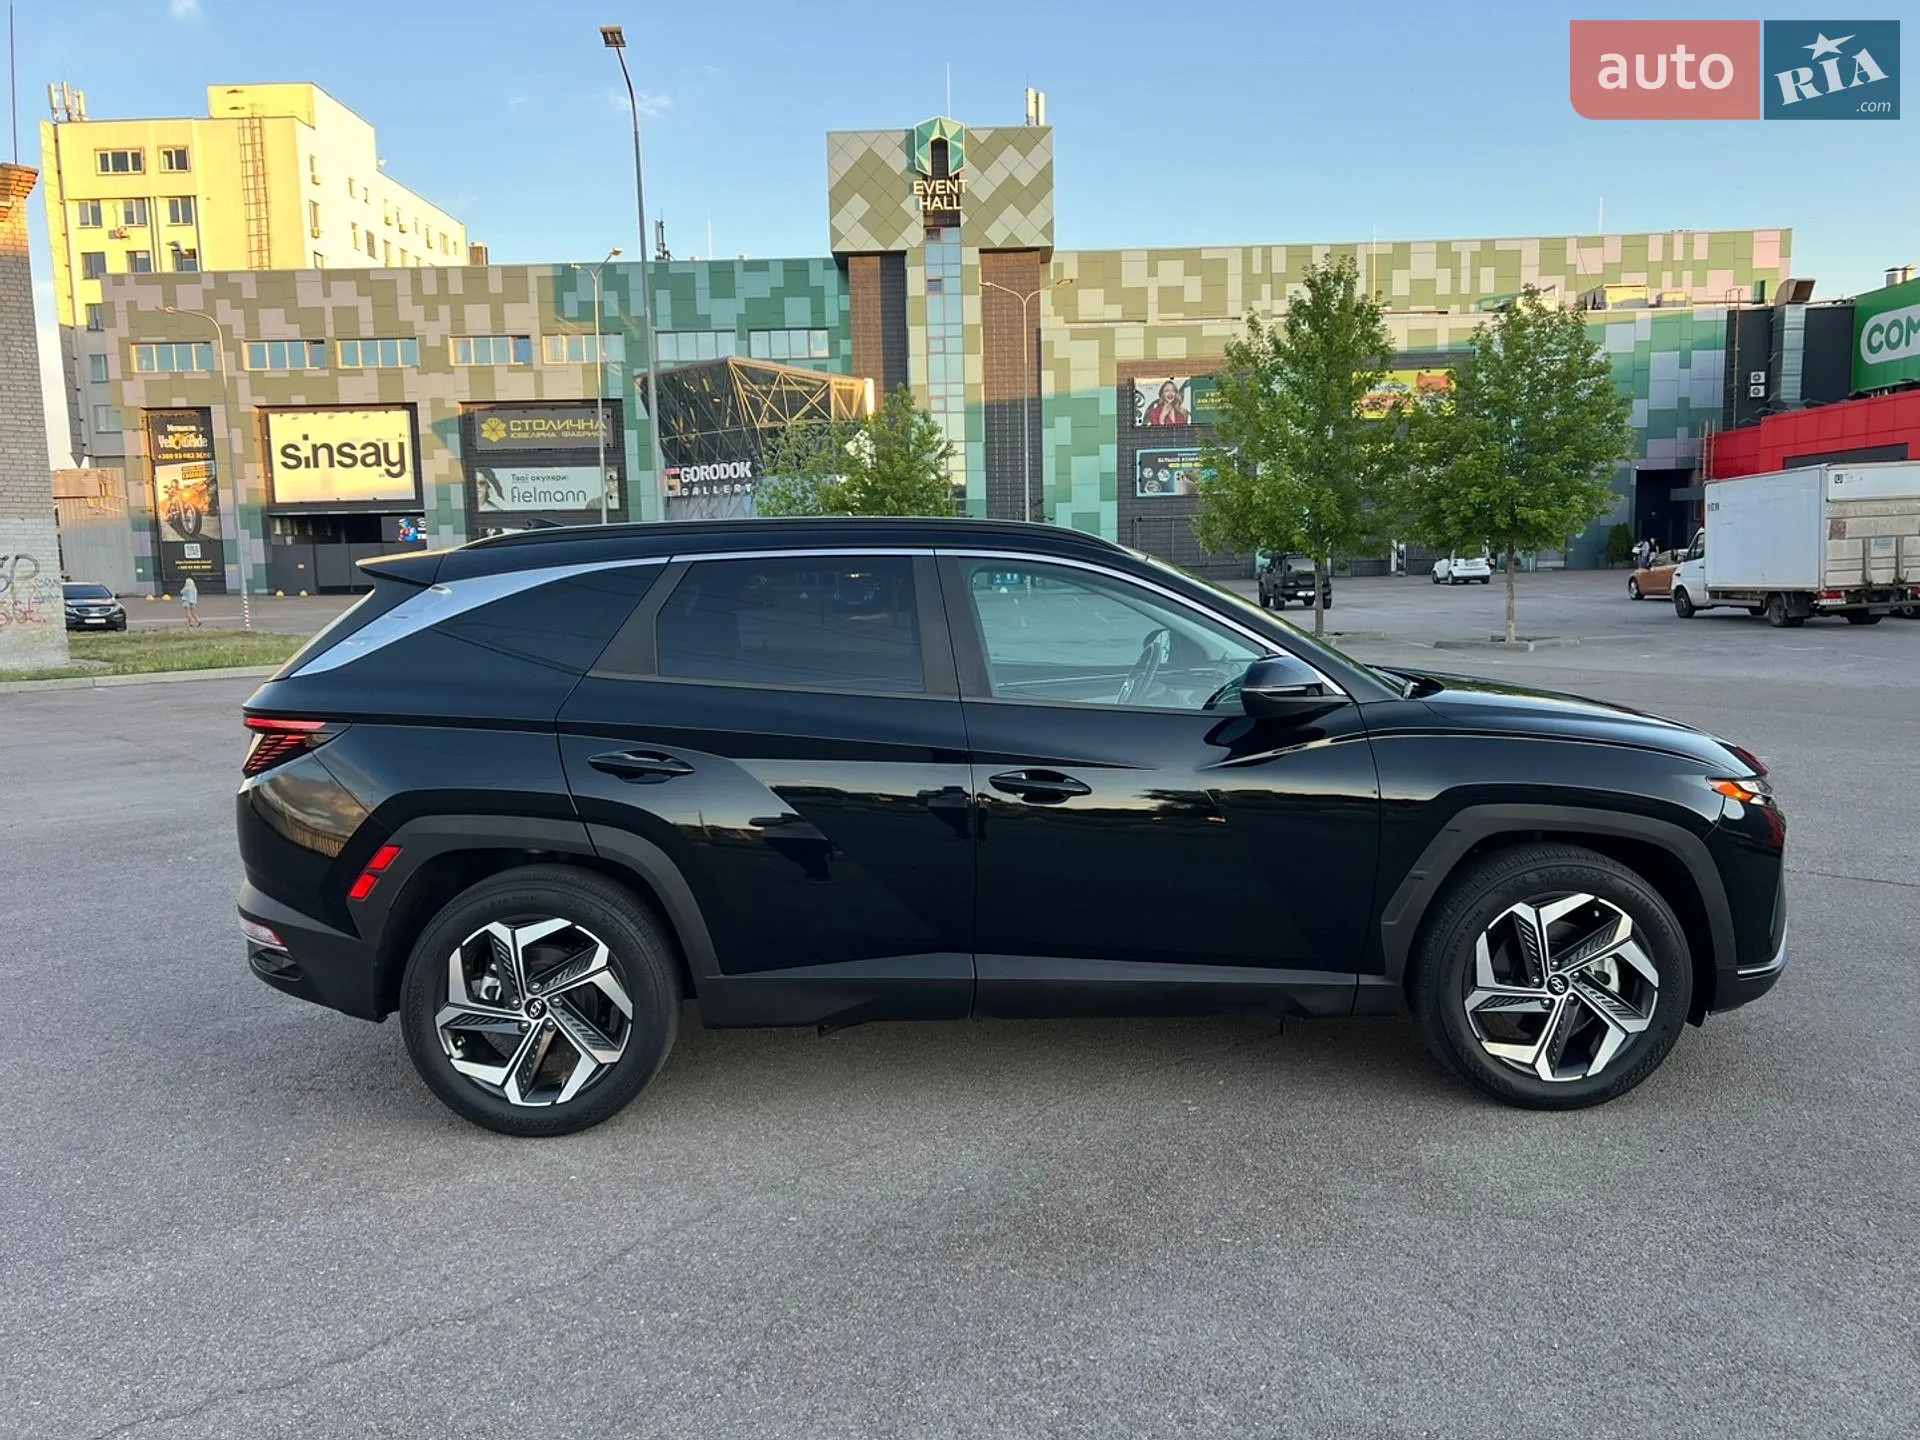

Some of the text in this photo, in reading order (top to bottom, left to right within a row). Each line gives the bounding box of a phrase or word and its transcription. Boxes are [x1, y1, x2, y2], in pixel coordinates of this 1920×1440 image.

[913, 179, 968, 195] EVENT
[919, 194, 963, 211] HALL
[509, 418, 608, 431] СТОЛИЧНА
[280, 433, 407, 479] sinsay
[680, 461, 753, 483] GORODOK
[681, 483, 753, 496] GALLERY
